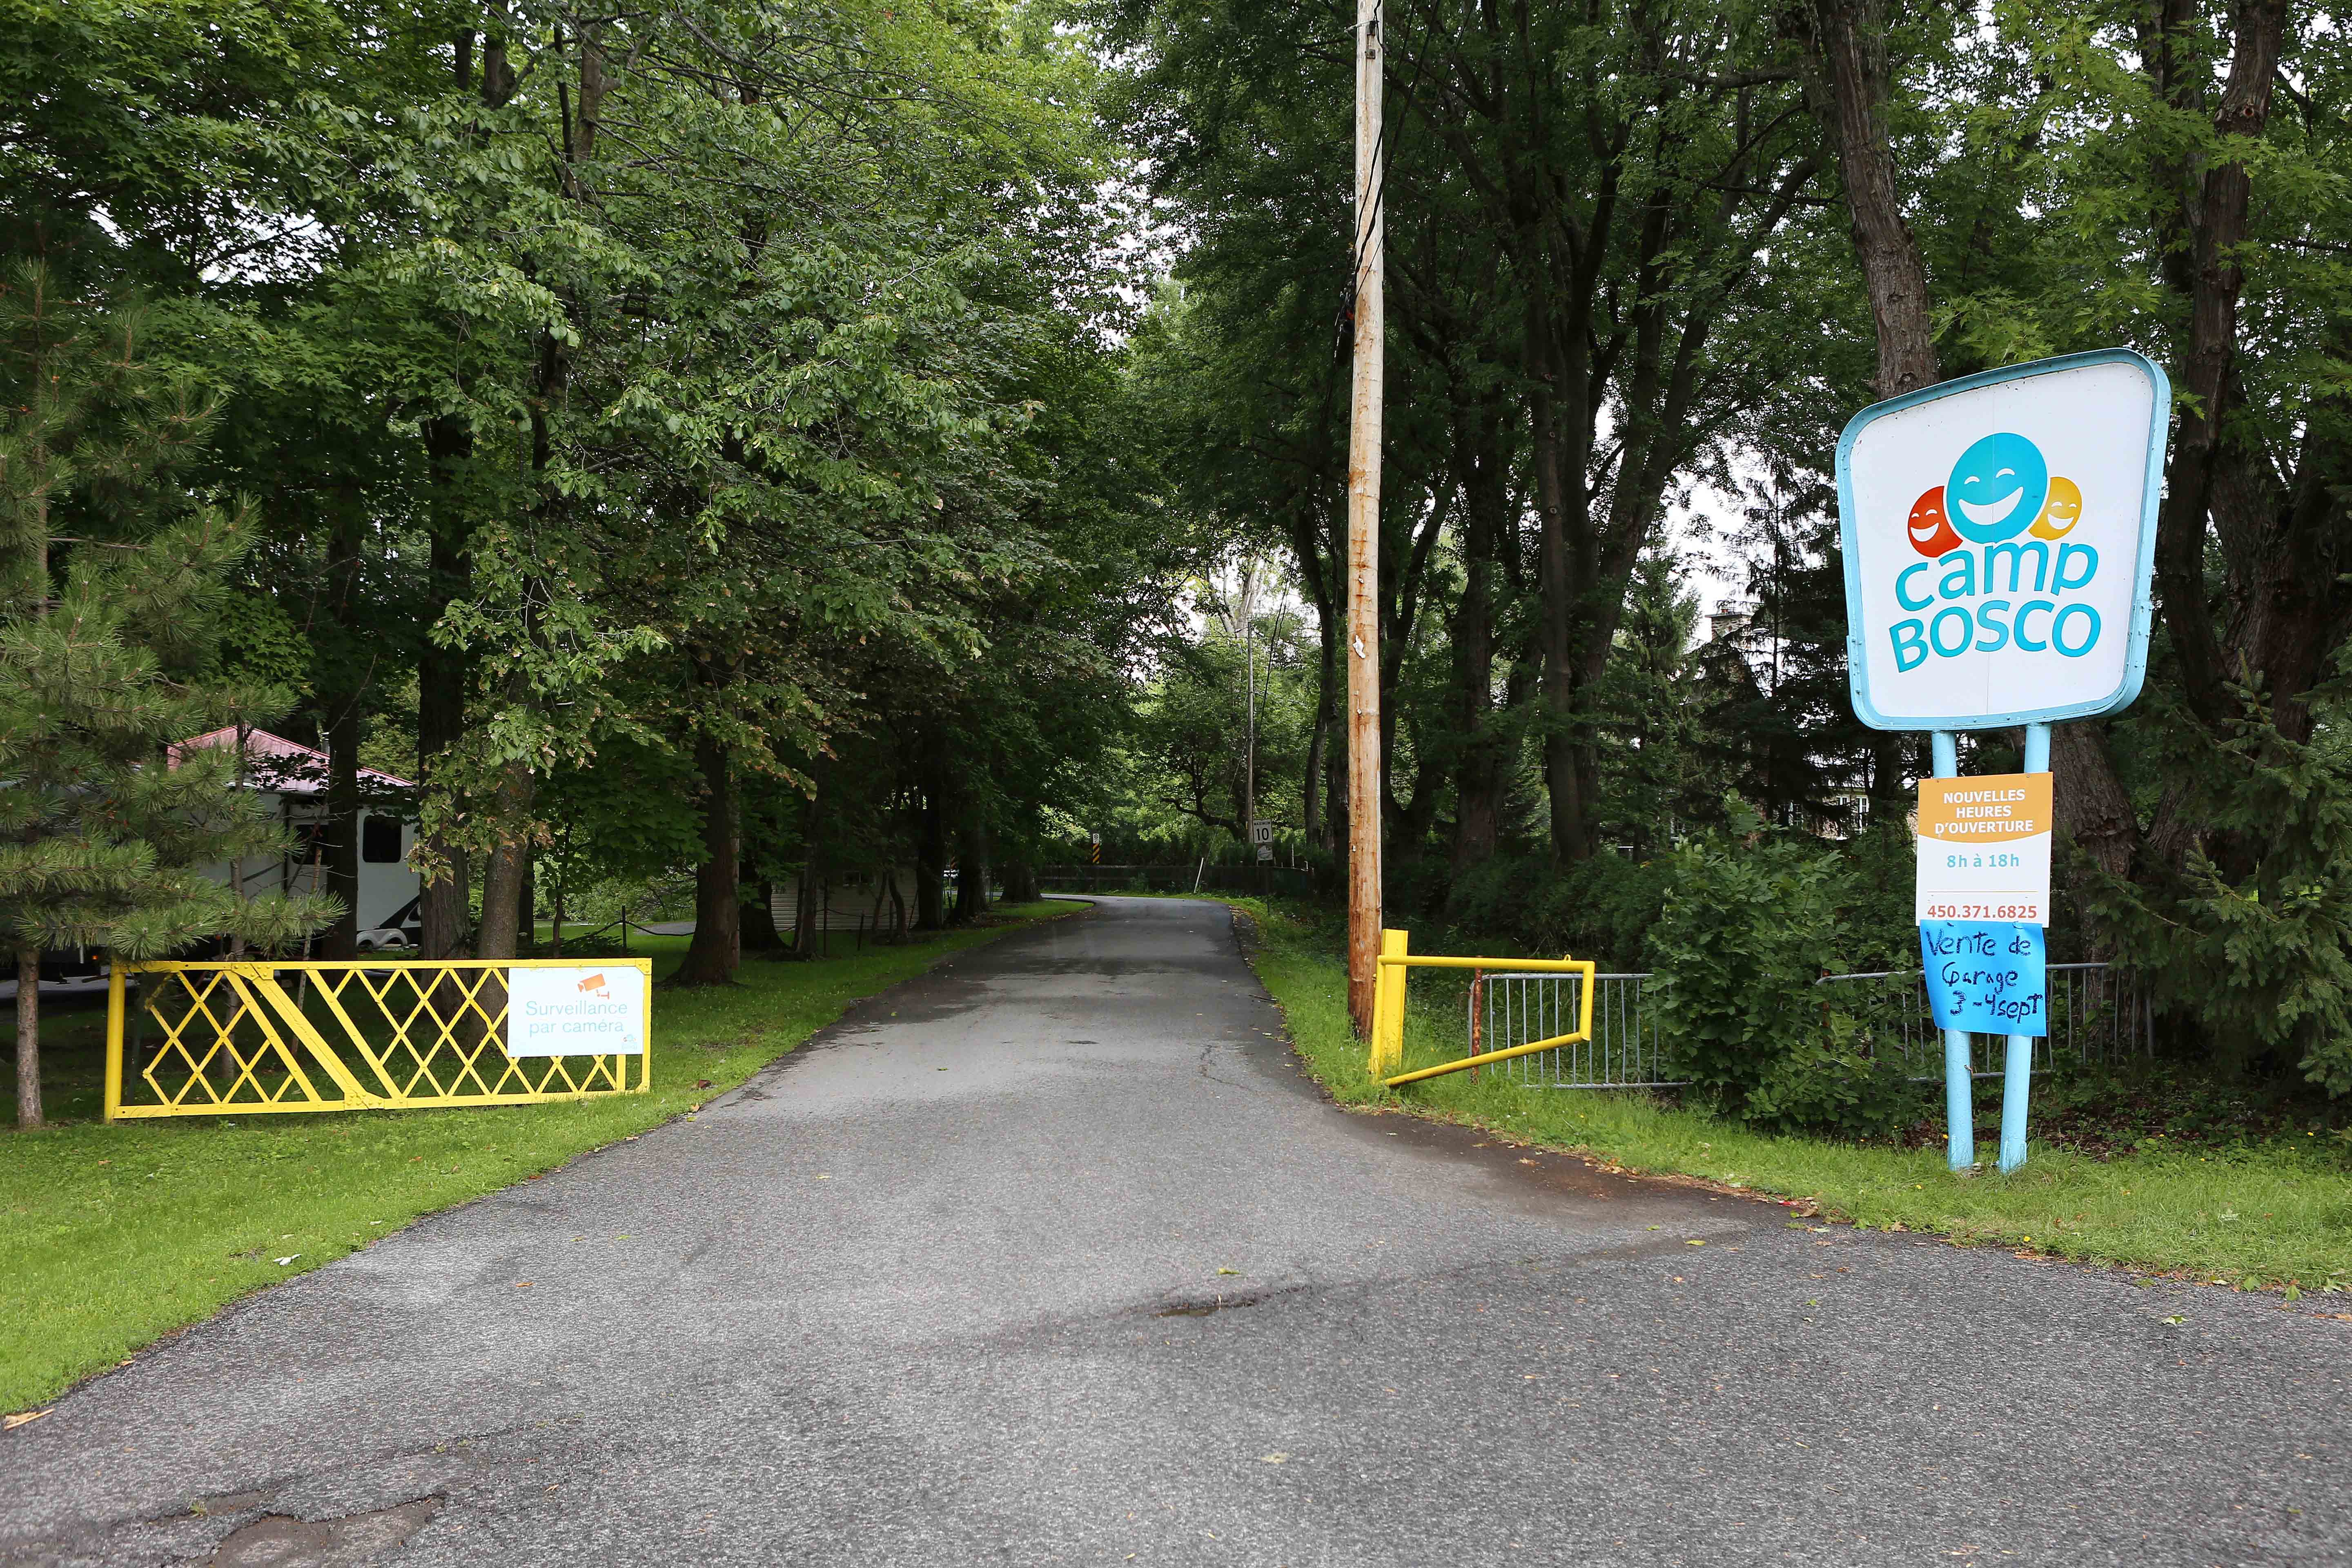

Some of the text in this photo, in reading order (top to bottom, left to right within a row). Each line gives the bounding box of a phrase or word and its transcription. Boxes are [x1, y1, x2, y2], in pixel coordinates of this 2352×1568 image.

[1895, 541, 2099, 612] camp
[1889, 600, 2101, 673] BOSCO
[1943, 789, 2026, 804] NOUVELLES
[1956, 805, 2012, 819] HEURES
[1256, 828, 1269, 841] 10
[1934, 820, 2034, 834] D'OUVERTURE
[1946, 853, 2020, 868] 8h à 18h
[1927, 905, 2037, 919] 450.371.6825
[1926, 928, 2031, 957] Vente de
[1942, 961, 2018, 995] Garage
[526, 1000, 628, 1016] Surveillance
[529, 1019, 624, 1038] par caméra
